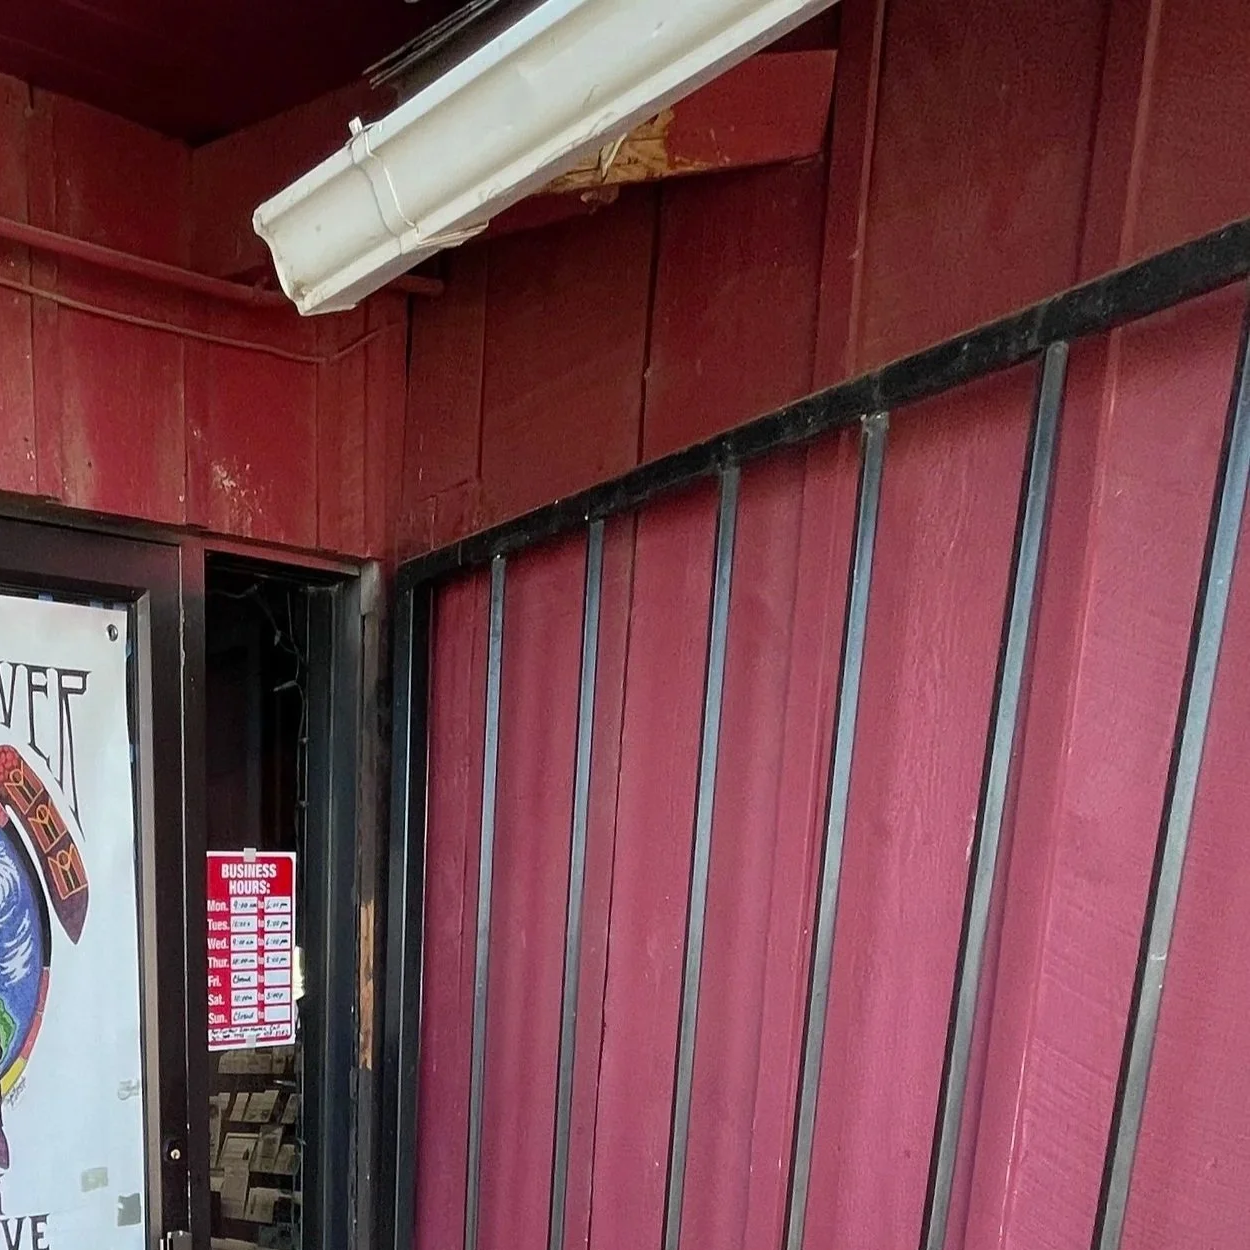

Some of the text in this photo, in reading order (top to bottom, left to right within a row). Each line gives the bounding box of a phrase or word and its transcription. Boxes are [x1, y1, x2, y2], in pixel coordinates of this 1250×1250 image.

[221, 863, 277, 879] BUSINESS
[229, 880, 271, 896] HOURS:
[207, 900, 229, 911] Mon.
[207, 918, 230, 931] Tues.
[207, 938, 229, 949] Wed.
[208, 957, 229, 968] Thur.
[208, 975, 222, 987] Fri.
[208, 994, 225, 1006] Sat.
[208, 1013, 228, 1024] Sun.
